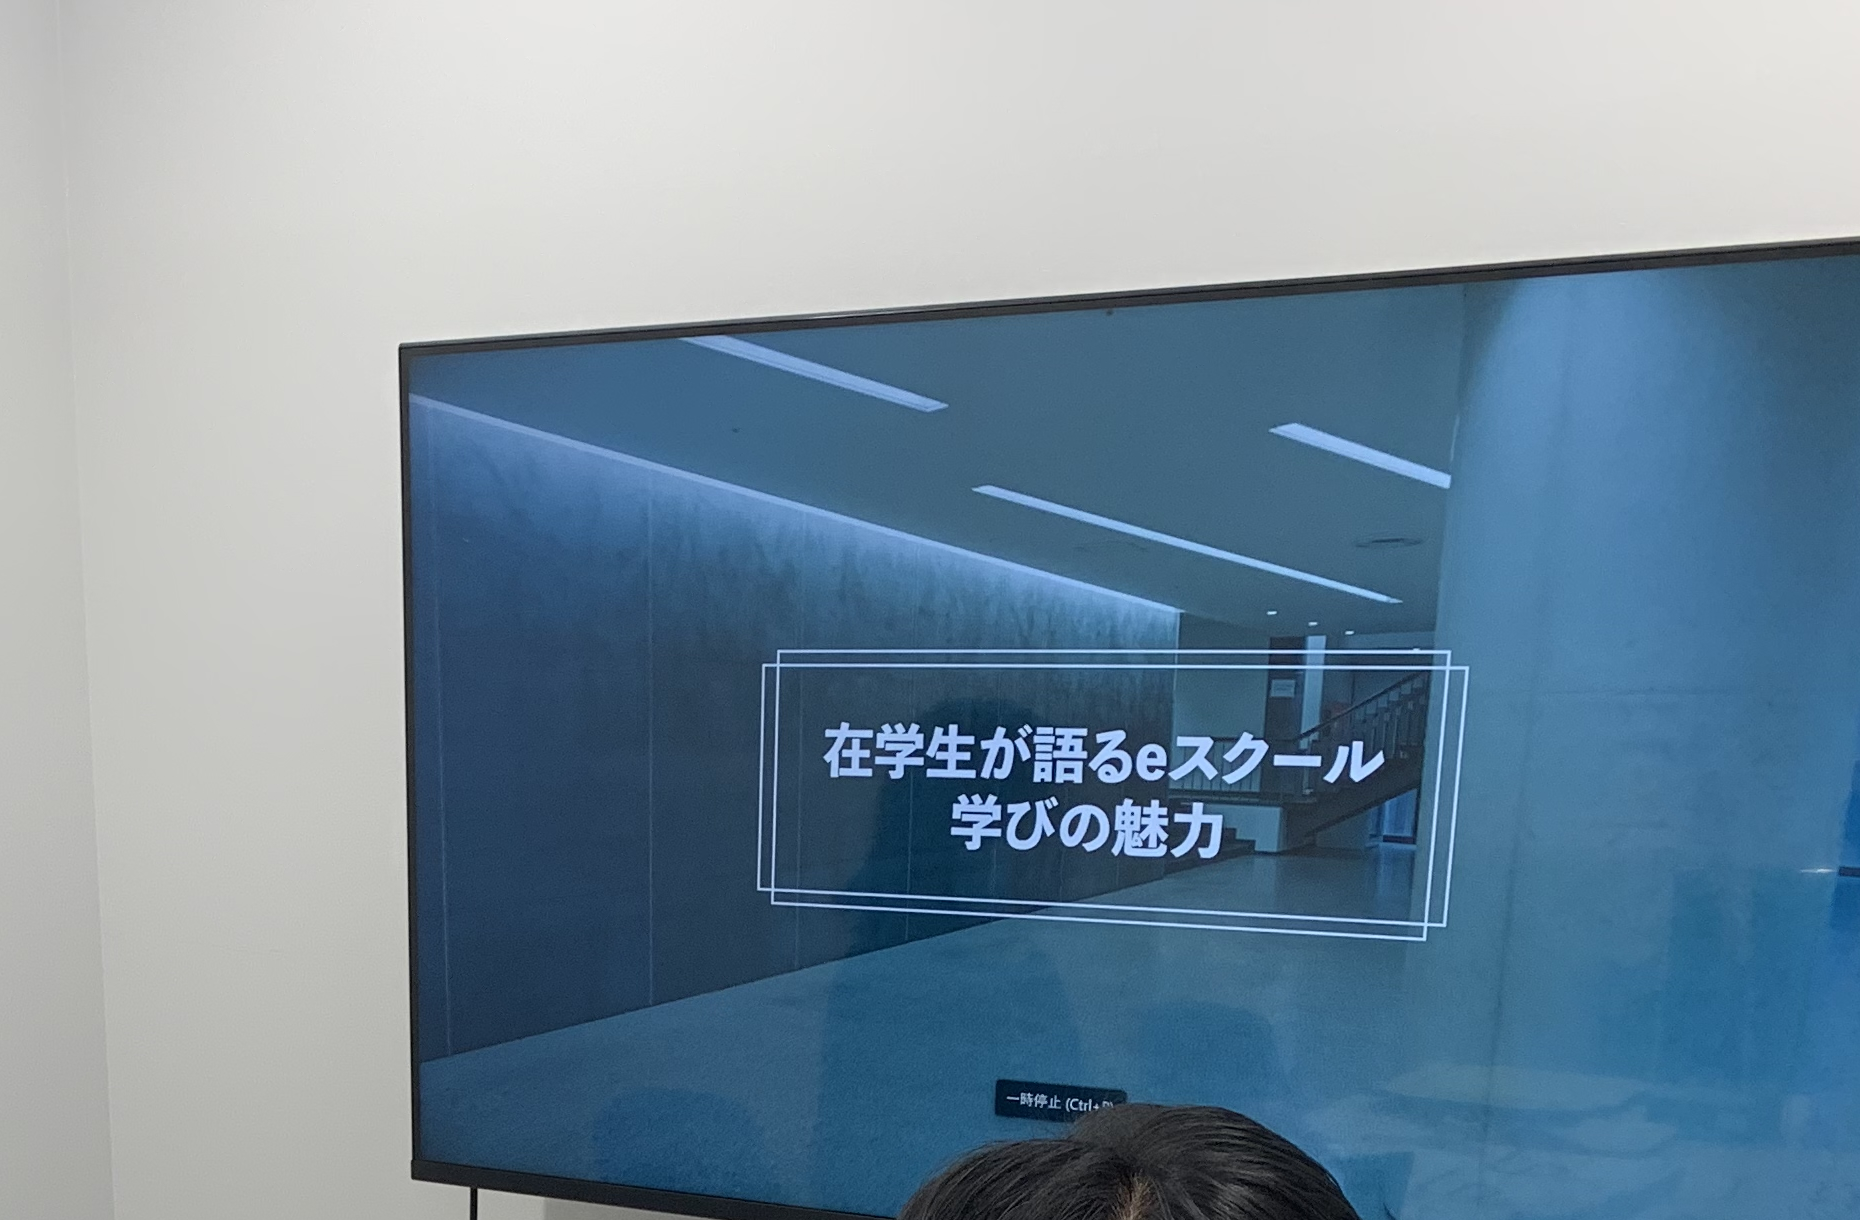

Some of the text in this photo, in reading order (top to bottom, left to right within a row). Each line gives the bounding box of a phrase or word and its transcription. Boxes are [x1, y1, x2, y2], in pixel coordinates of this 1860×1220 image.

[822, 721, 1386, 786] 在学生が語るeスクール
[950, 794, 1225, 859] 学びの魅力
[1006, 1092, 1062, 1110] 一時停止
